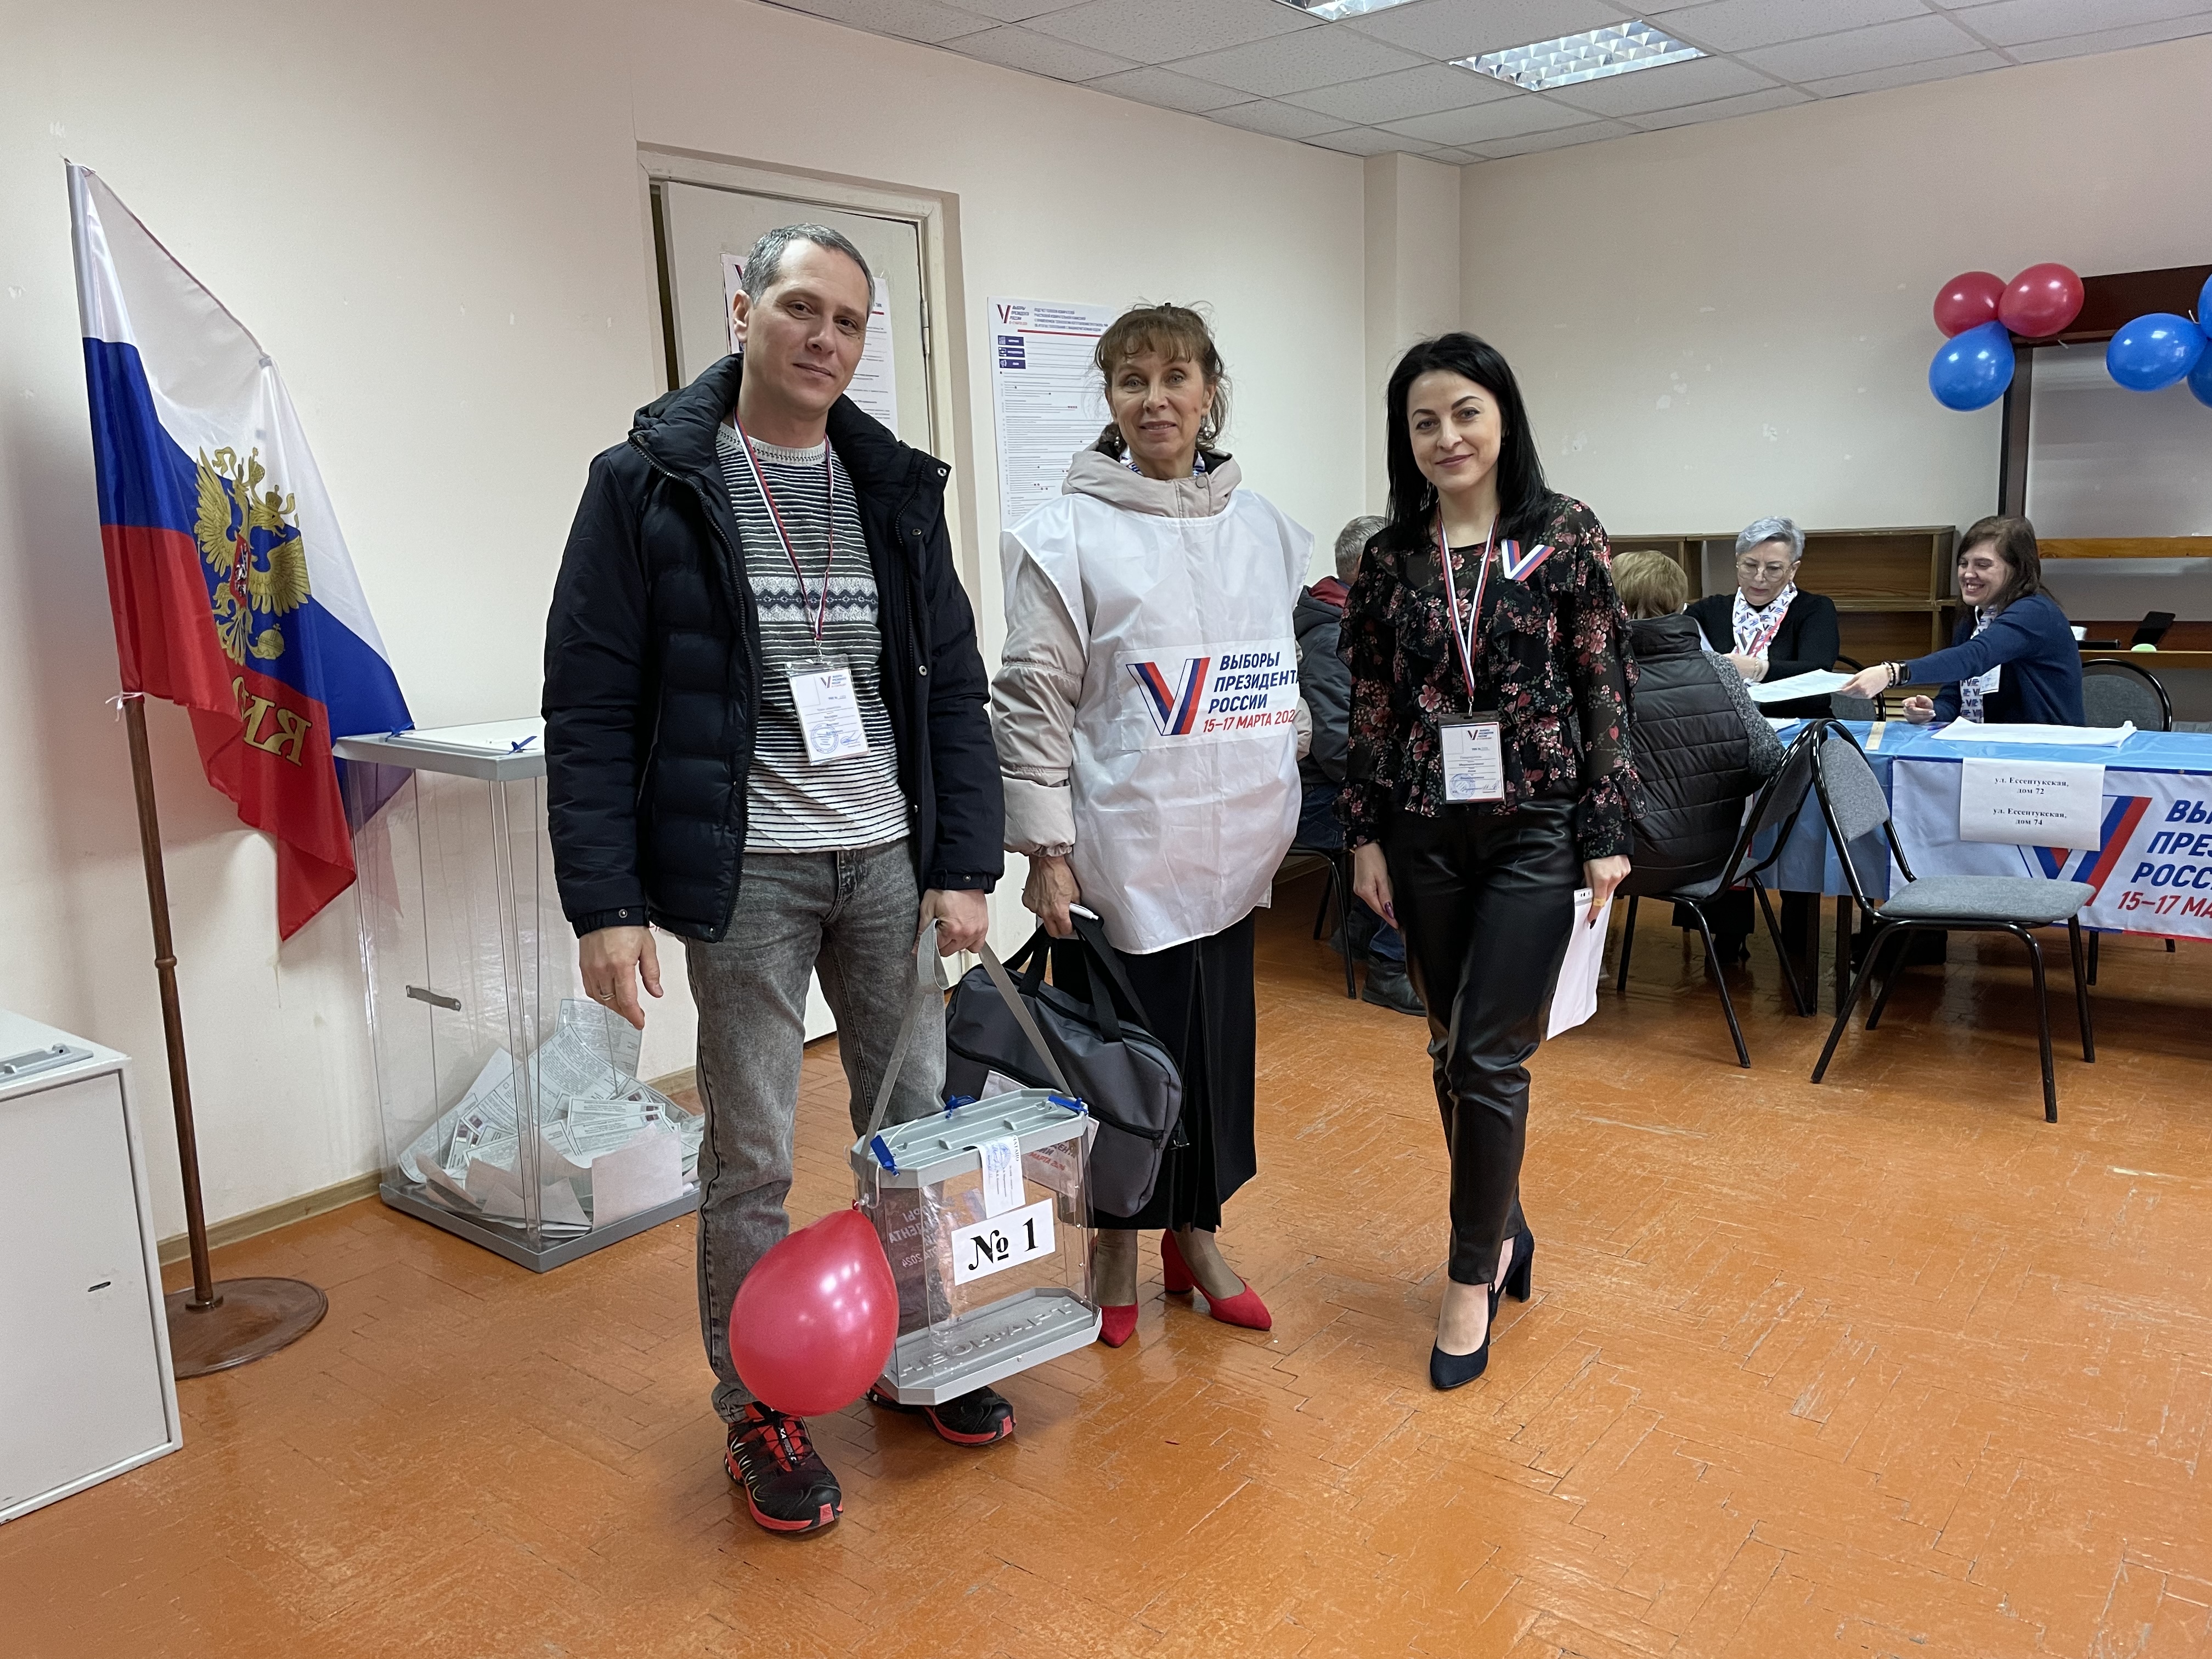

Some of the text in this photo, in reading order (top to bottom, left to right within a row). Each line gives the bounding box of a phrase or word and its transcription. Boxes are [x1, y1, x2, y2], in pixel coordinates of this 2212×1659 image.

[1220, 651, 1280, 671] ВЫБОРЫ
[1208, 693, 1268, 714] РОССИИ
[1235, 713, 1272, 730] МАРТА
[1274, 709, 1296, 725] 202
[2009, 777, 2069, 787] Ессентукская,
[2007, 808, 2067, 819] Ессентукская,
[2147, 831, 2212, 858] ПРЕ
[2131, 862, 2212, 890] РОСС
[1022, 1217, 1039, 1252] 1
